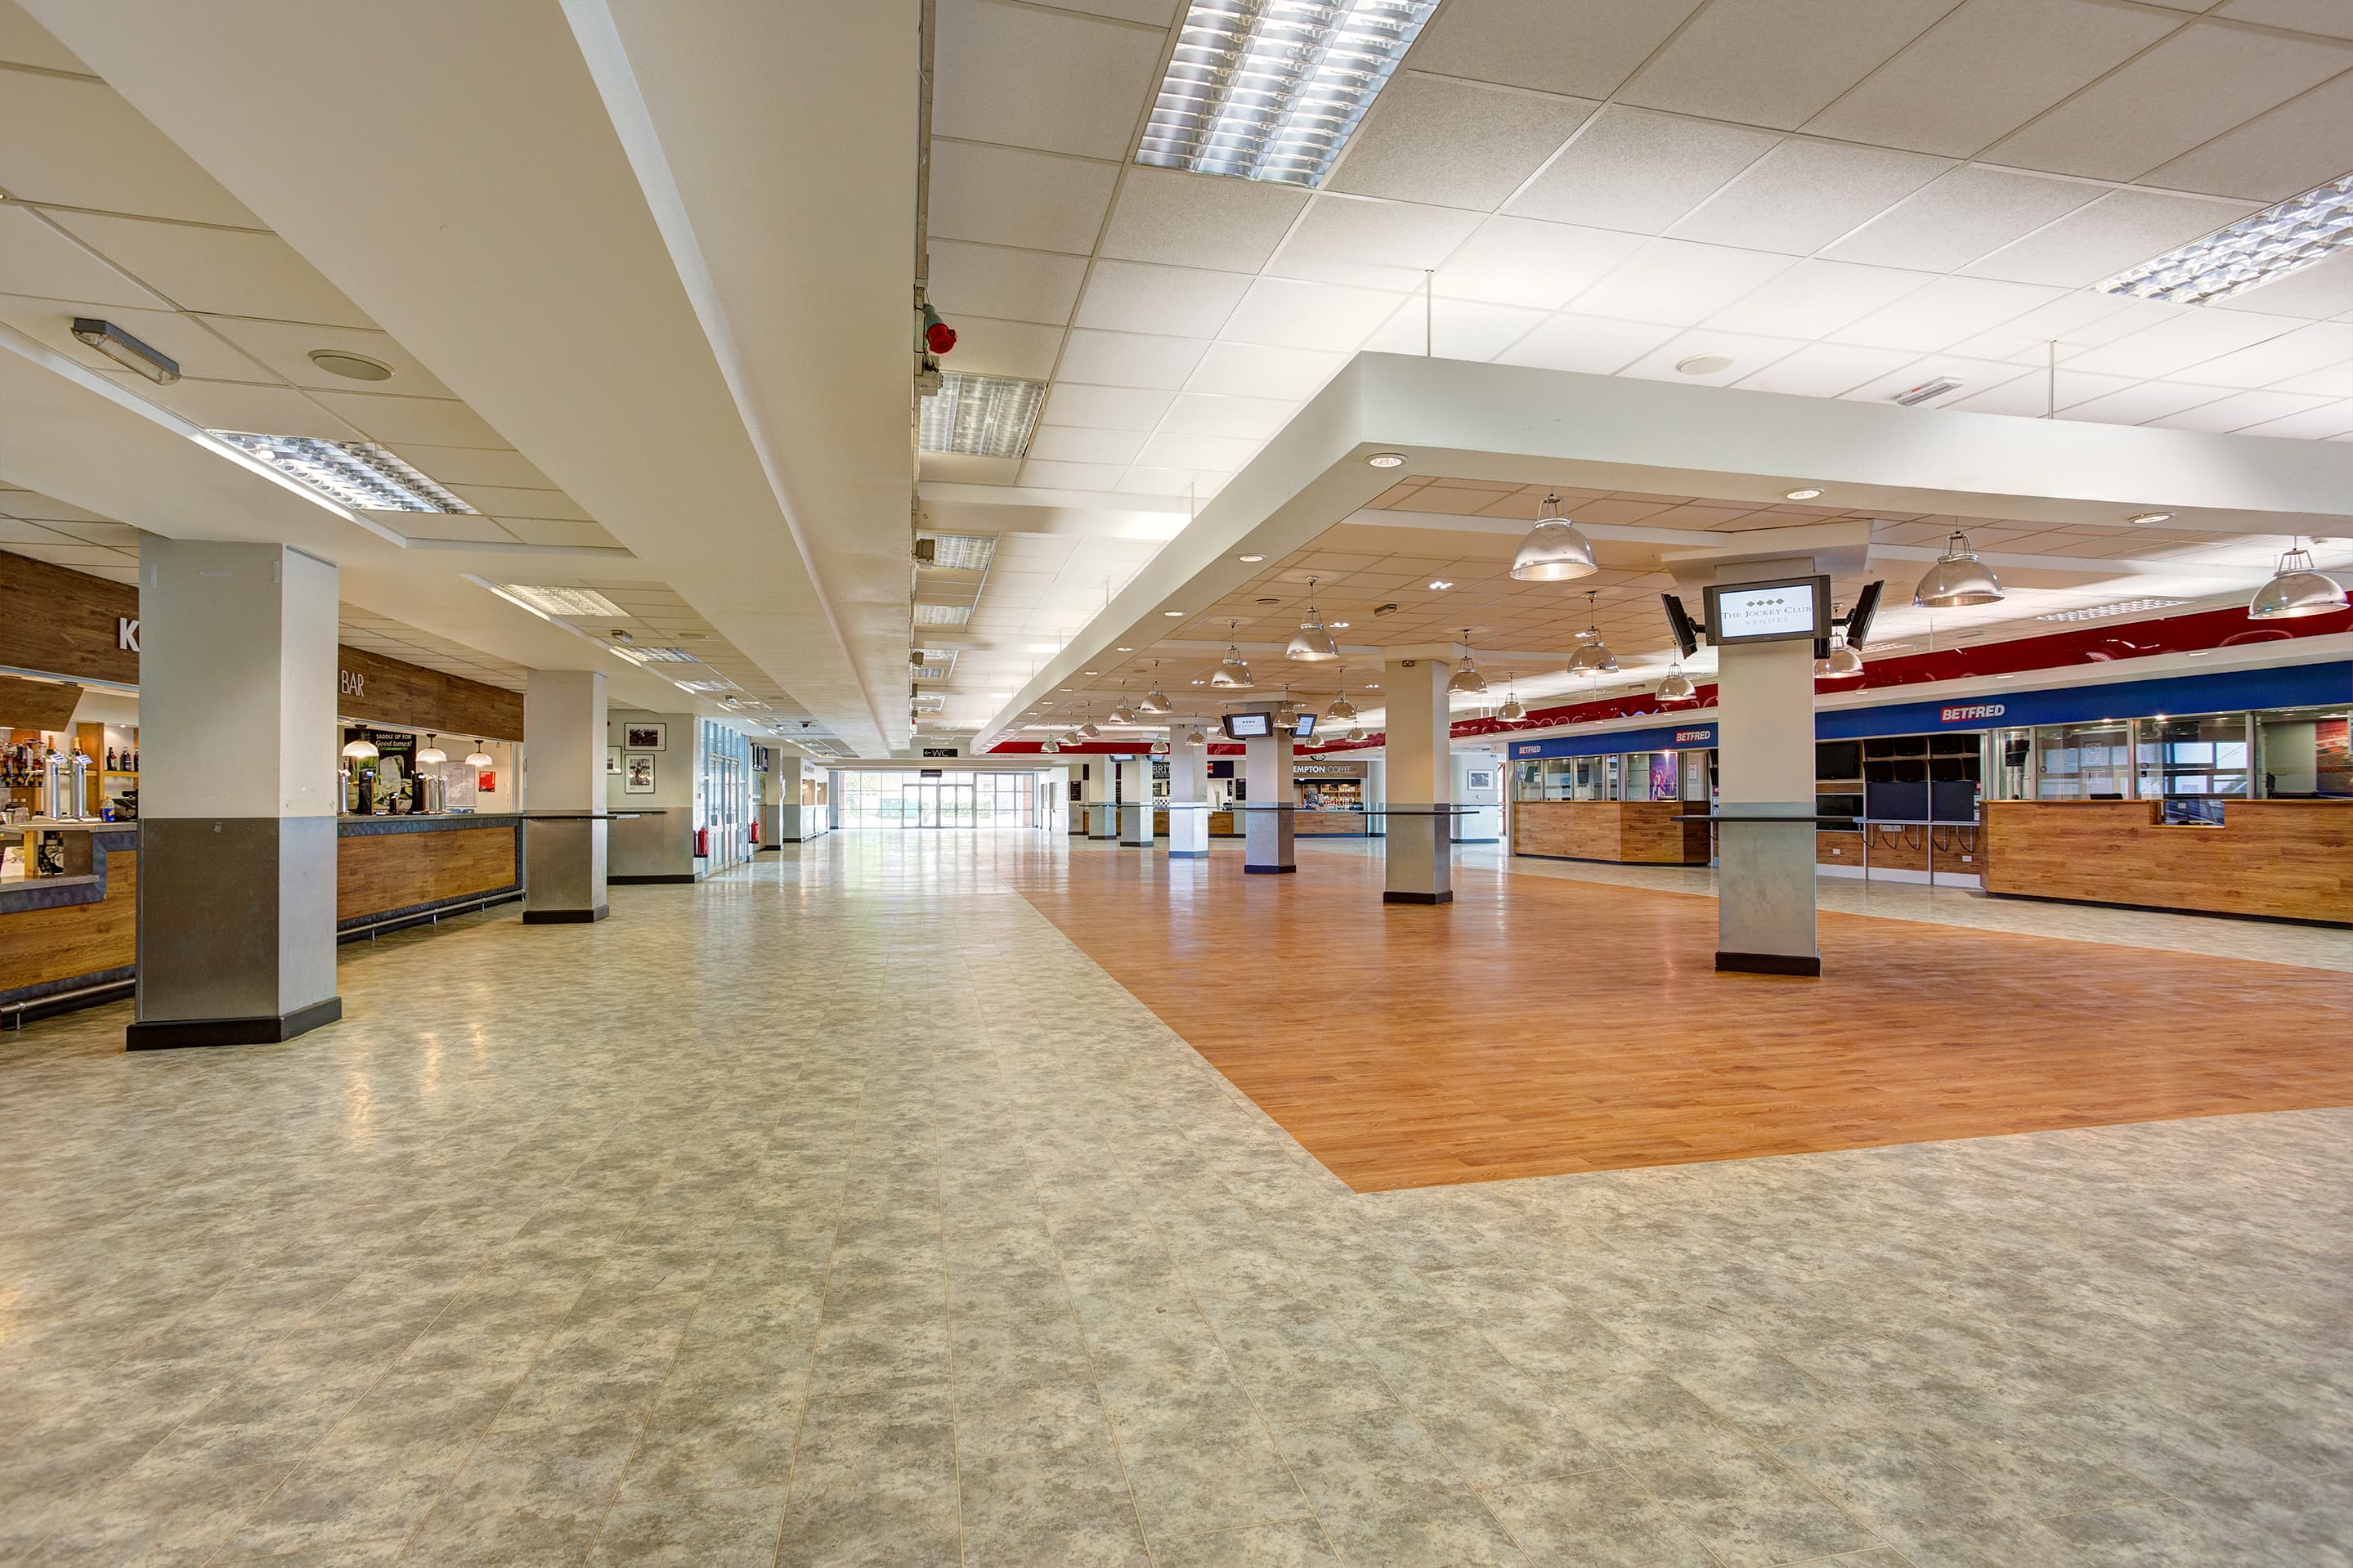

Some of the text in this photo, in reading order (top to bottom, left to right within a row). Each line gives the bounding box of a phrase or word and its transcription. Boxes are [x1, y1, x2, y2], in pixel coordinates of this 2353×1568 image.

[1746, 609, 1782, 618] JOCKEY
[1746, 617, 1789, 625] VENUES
[341, 670, 365, 697] BAR
[1942, 704, 2006, 721] BETFRED
[1676, 730, 1710, 741] BETFRED
[1519, 745, 1541, 754] BETFRED
[1153, 765, 1170, 773] BRIT
[1293, 765, 1325, 773] EMPTON
